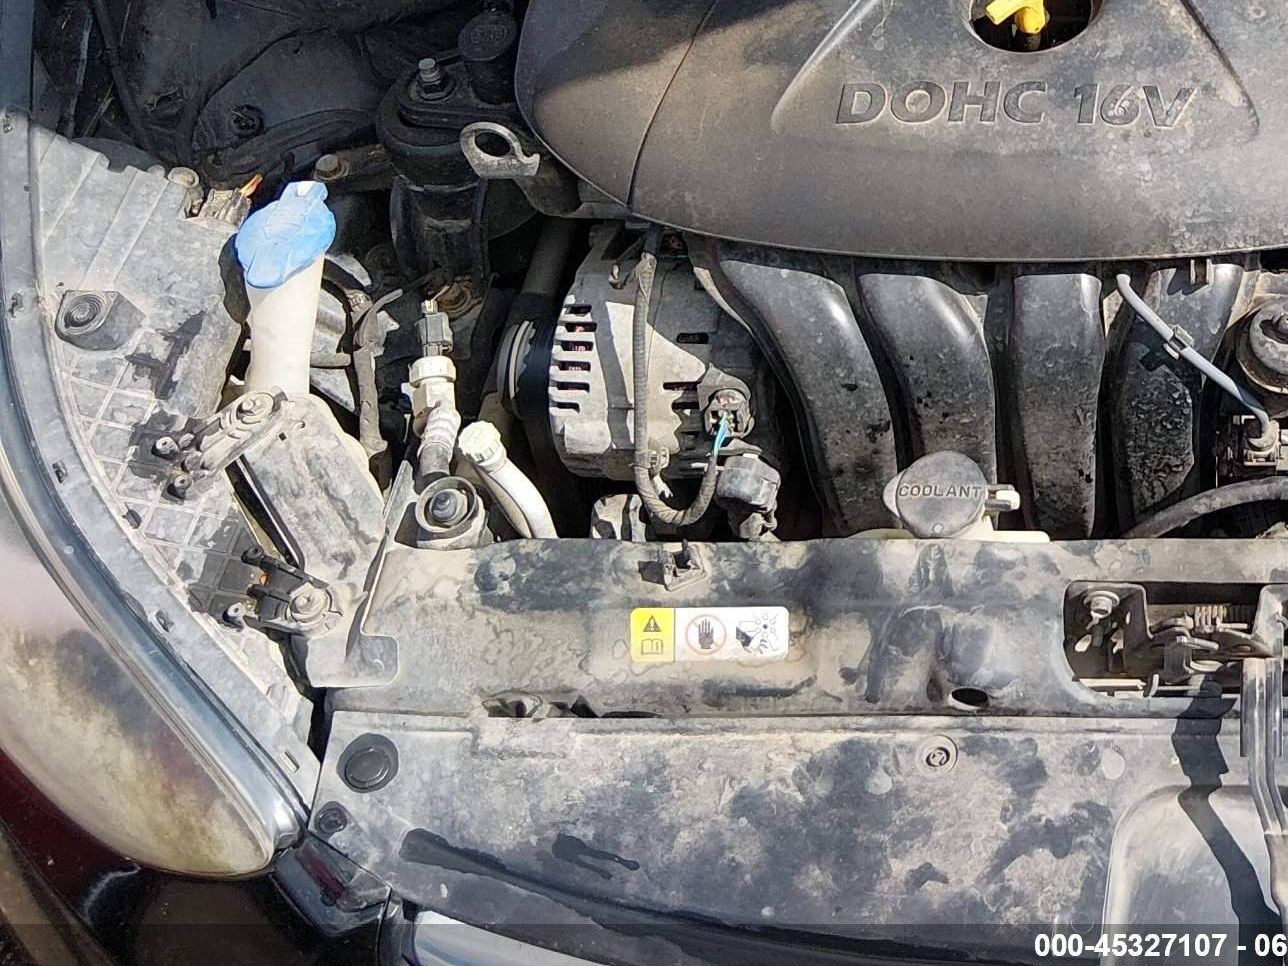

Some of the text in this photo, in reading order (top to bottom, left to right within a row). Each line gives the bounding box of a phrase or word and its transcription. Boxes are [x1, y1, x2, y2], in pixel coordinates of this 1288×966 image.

[835, 80, 1200, 129] DOHC 16V
[898, 484, 982, 499] COOLANT
